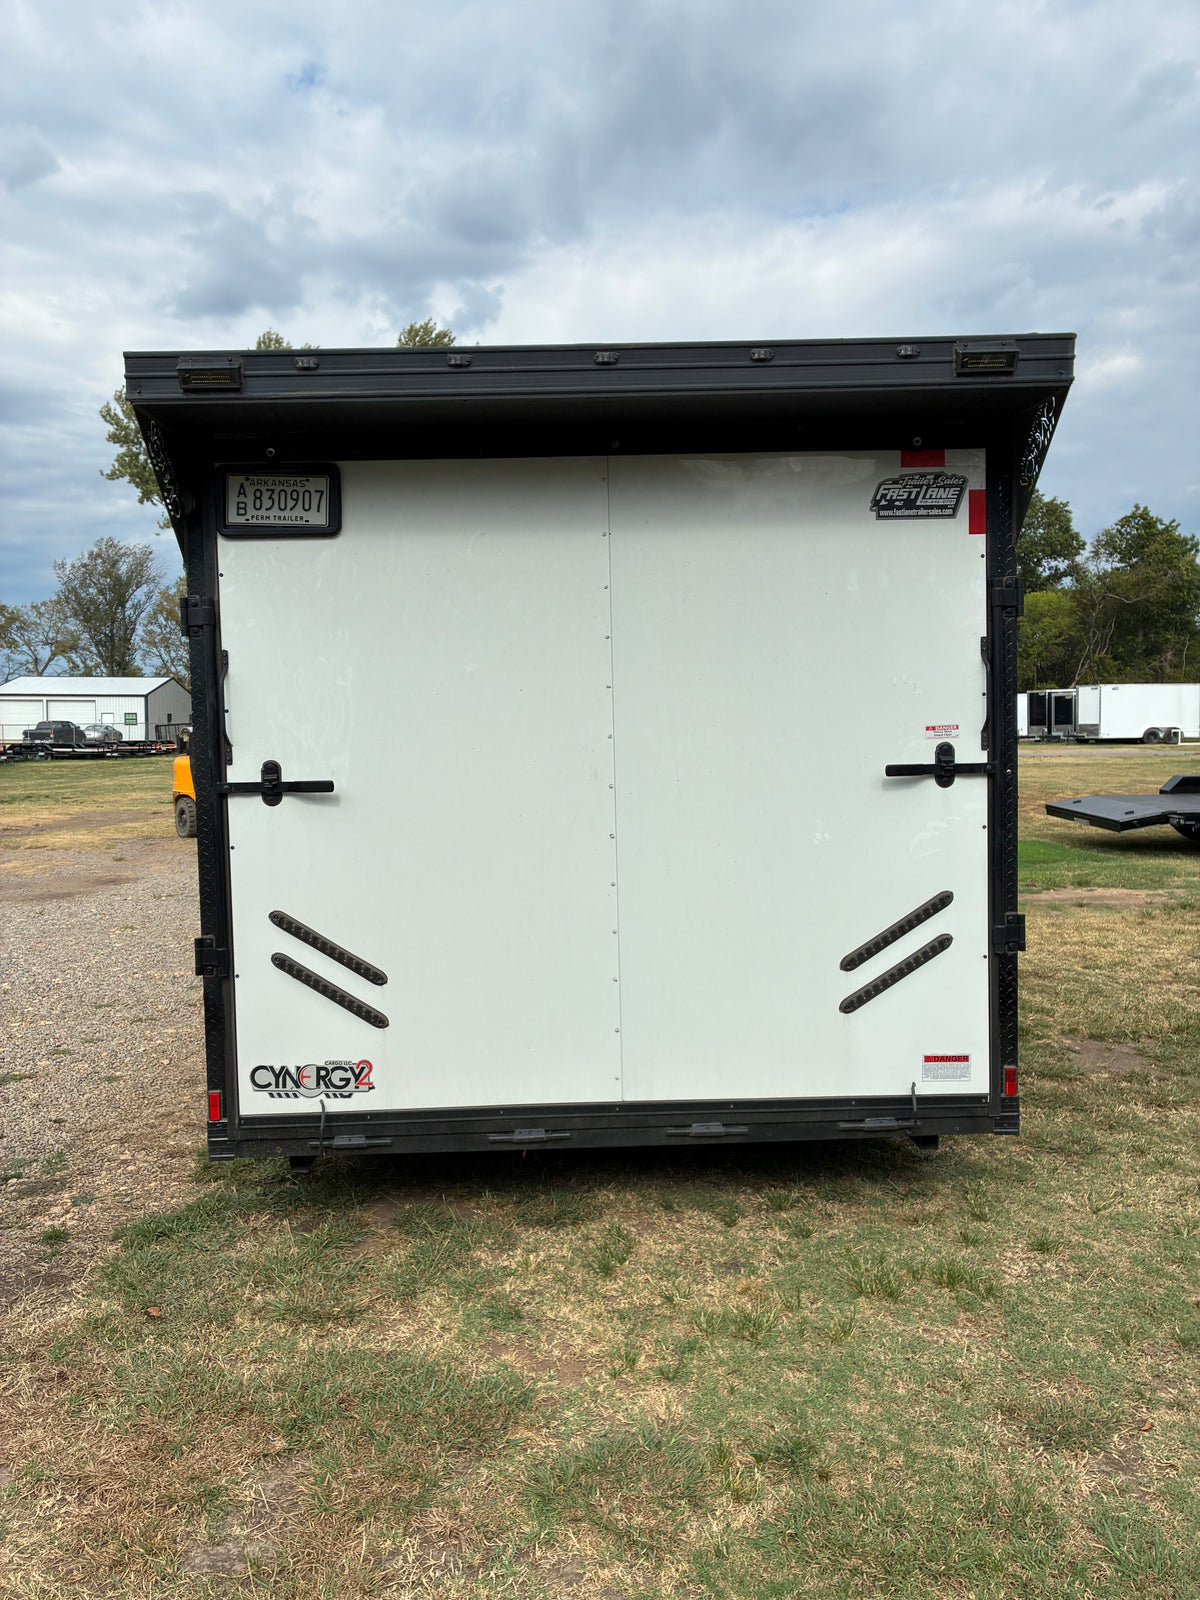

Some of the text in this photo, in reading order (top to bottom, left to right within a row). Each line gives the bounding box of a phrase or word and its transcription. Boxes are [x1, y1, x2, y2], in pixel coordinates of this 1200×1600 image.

[249, 478, 306, 488] ARKANSAS
[899, 475, 965, 487] Trailer Sales
[252, 488, 325, 513] 830907
[933, 1055, 970, 1063] DANGER
